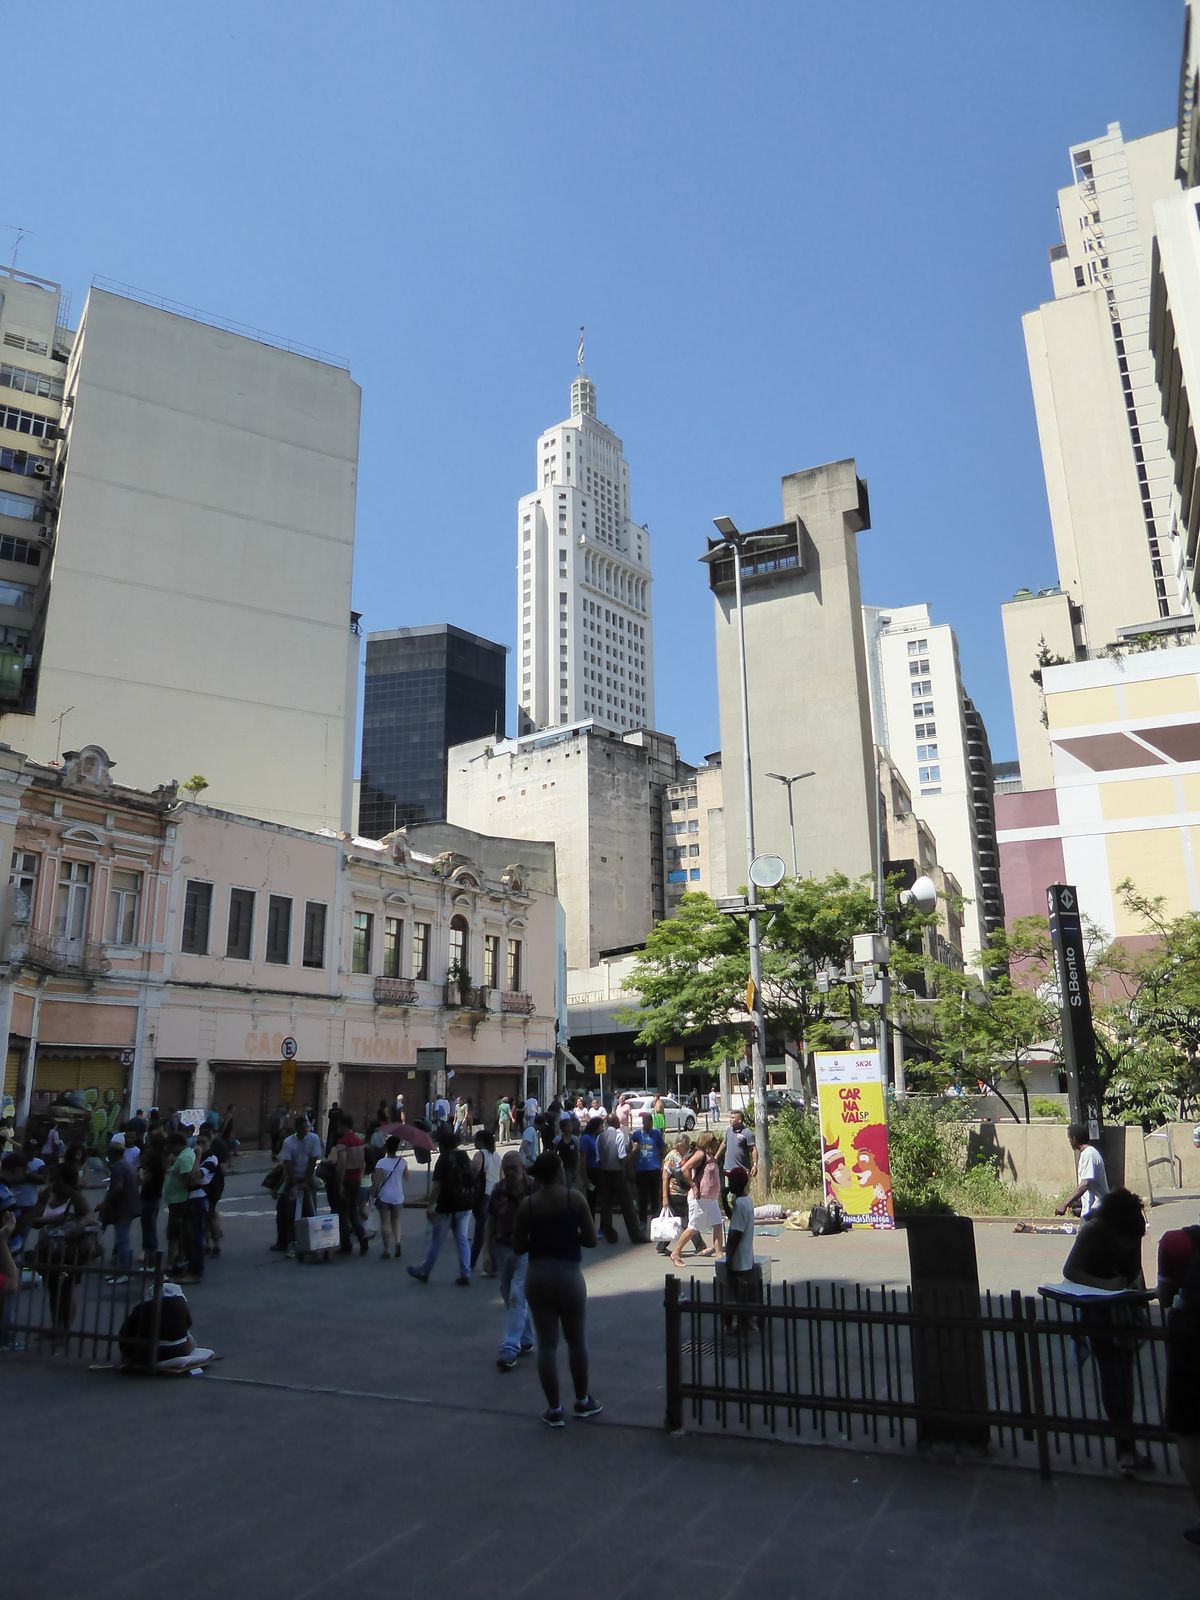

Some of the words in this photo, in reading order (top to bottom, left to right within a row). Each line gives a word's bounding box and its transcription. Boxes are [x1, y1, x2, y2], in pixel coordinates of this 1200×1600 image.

[1066, 947, 1082, 1007] S.Bento
[245, 1031, 298, 1057] CAS
[860, 1037, 873, 1045] 190
[838, 1087, 861, 1100] CAR
[843, 1100, 859, 1113] NA
[841, 1111, 863, 1124] VAL
